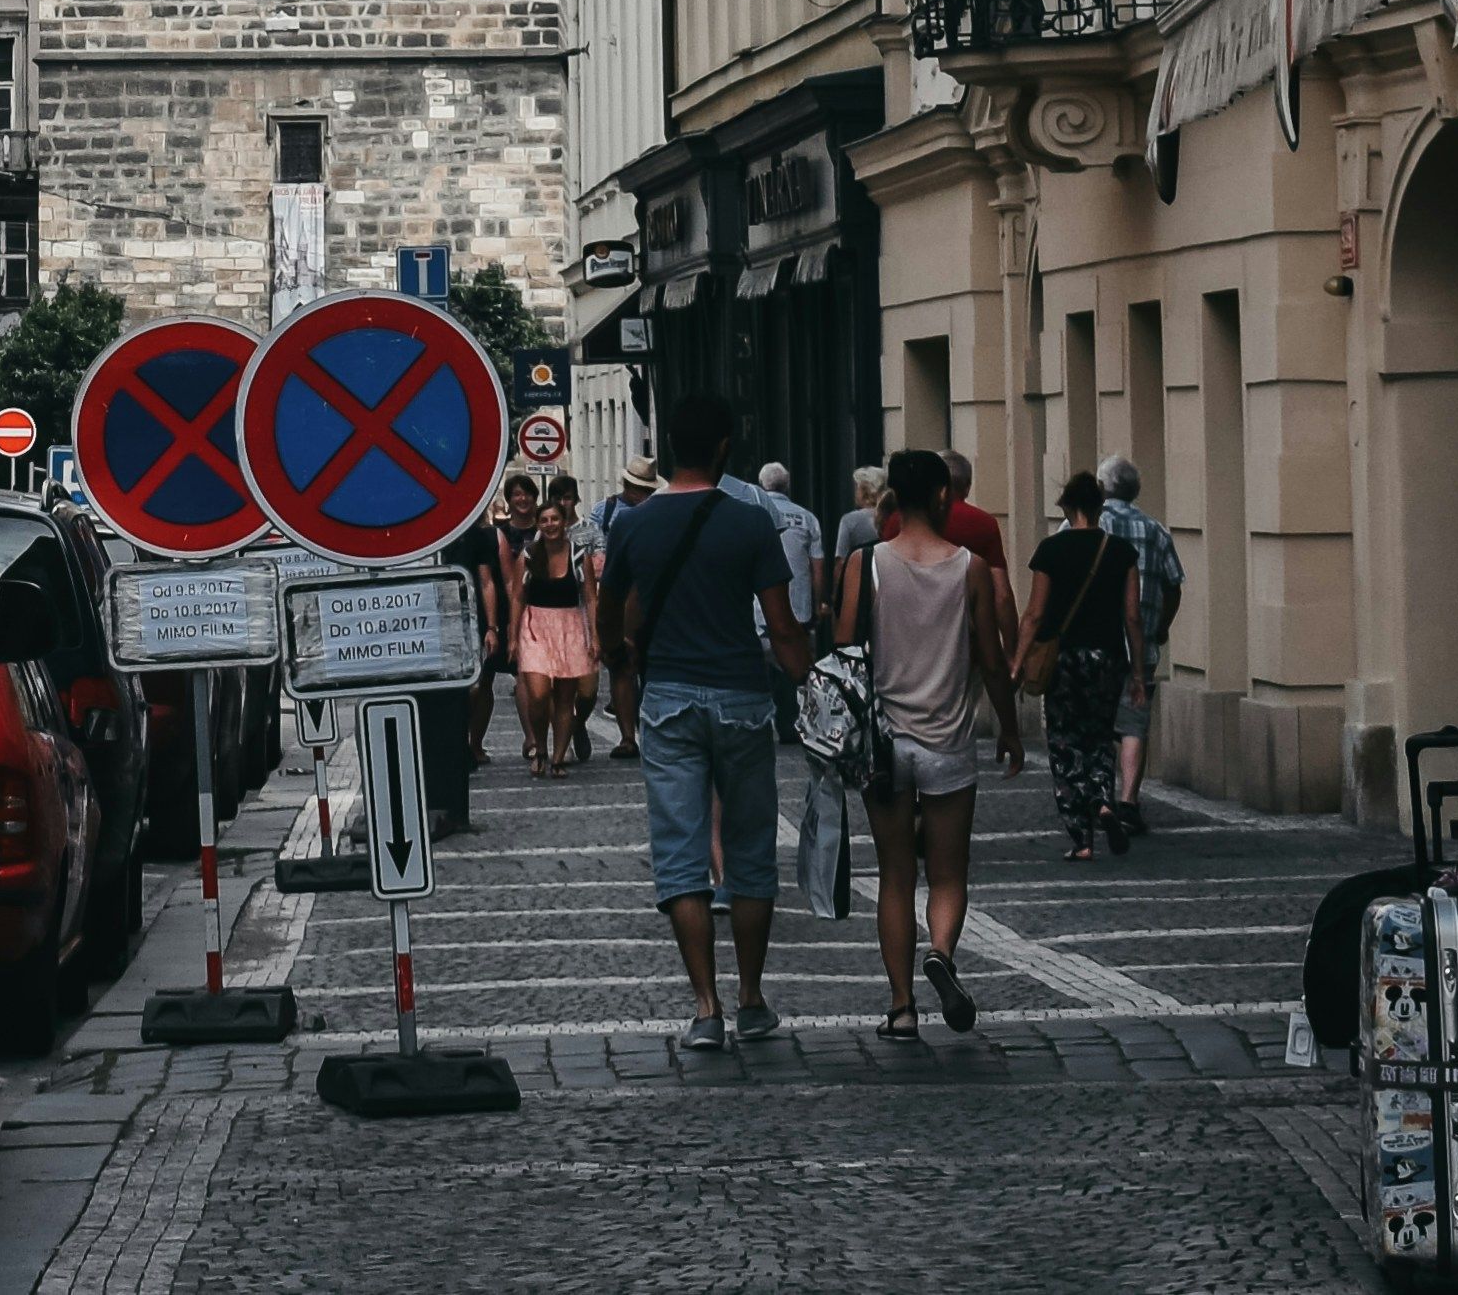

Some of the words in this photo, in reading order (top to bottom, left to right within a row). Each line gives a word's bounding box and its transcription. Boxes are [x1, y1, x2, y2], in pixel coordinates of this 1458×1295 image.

[152, 585, 172, 599] Od
[175, 580, 233, 597] 9.8.2017
[150, 607, 170, 620] Do
[173, 602, 238, 618] 10.8.2017
[331, 599, 355, 614] Od
[358, 593, 422, 612] 9.8.2017
[157, 625, 197, 641] MIMO
[201, 622, 235, 638] FILM
[330, 623, 352, 638] Do
[356, 616, 428, 635] 10.8.2017
[338, 644, 383, 661] MIMO
[388, 640, 426, 657] FILM
